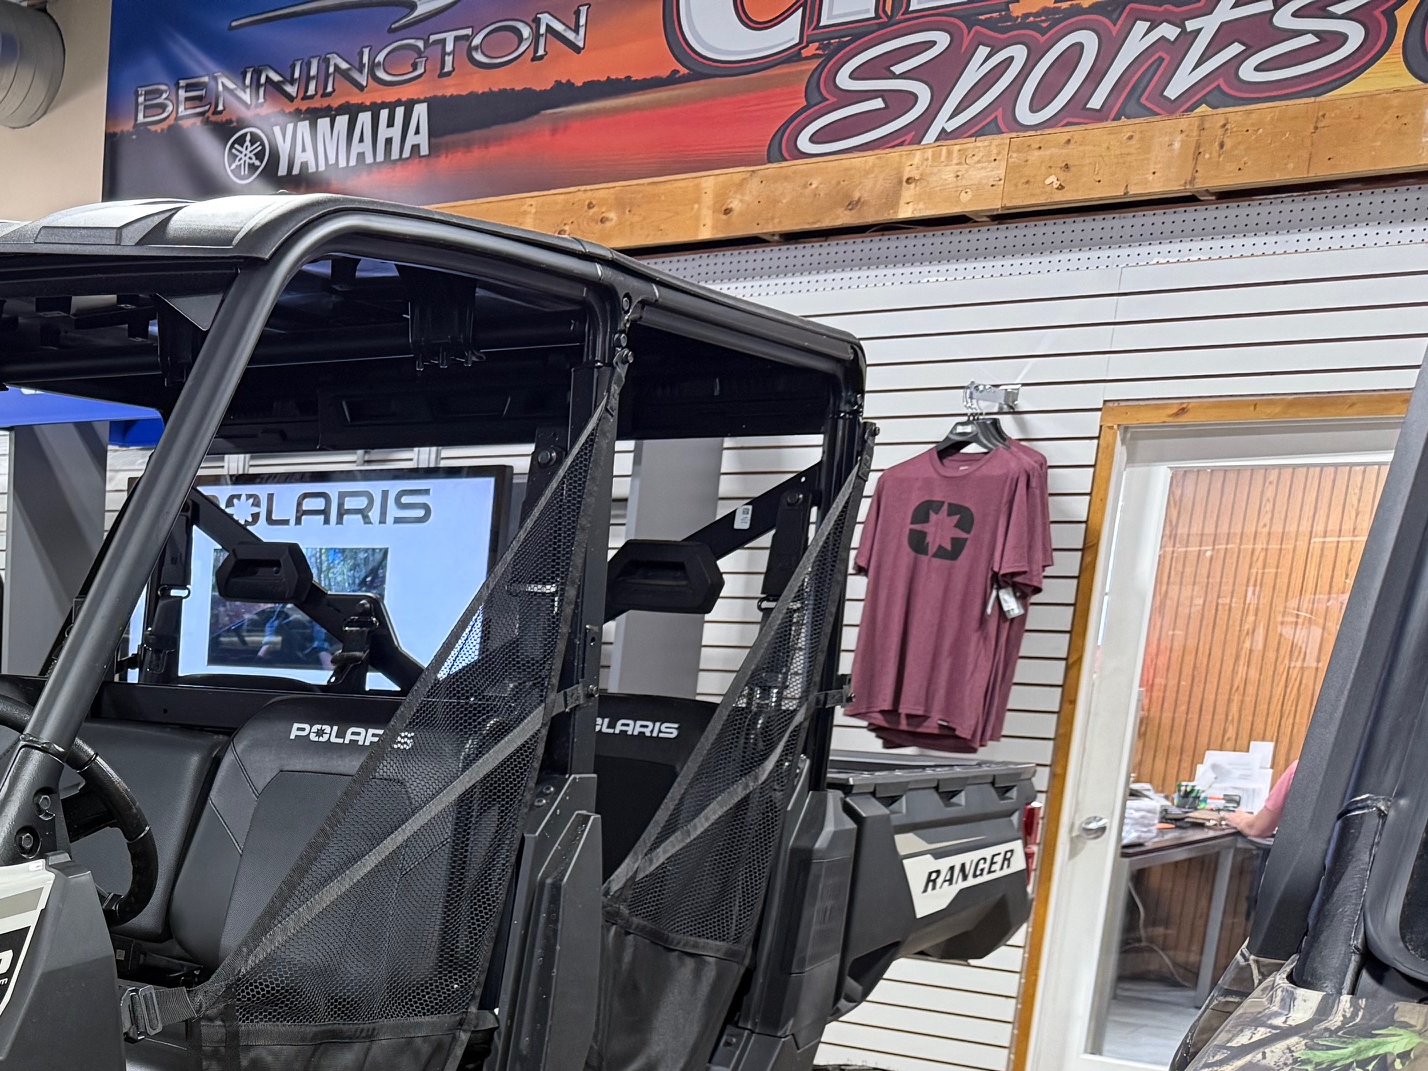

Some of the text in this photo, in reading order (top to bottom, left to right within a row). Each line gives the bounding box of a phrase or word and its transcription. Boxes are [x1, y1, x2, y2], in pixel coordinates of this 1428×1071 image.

[135, 3, 589, 128] BENNINGTON
[794, 0, 1372, 154] Sports
[274, 102, 430, 177] YAMAHA
[595, 717, 680, 739] LARIS
[921, 849, 1015, 894] RANGER
